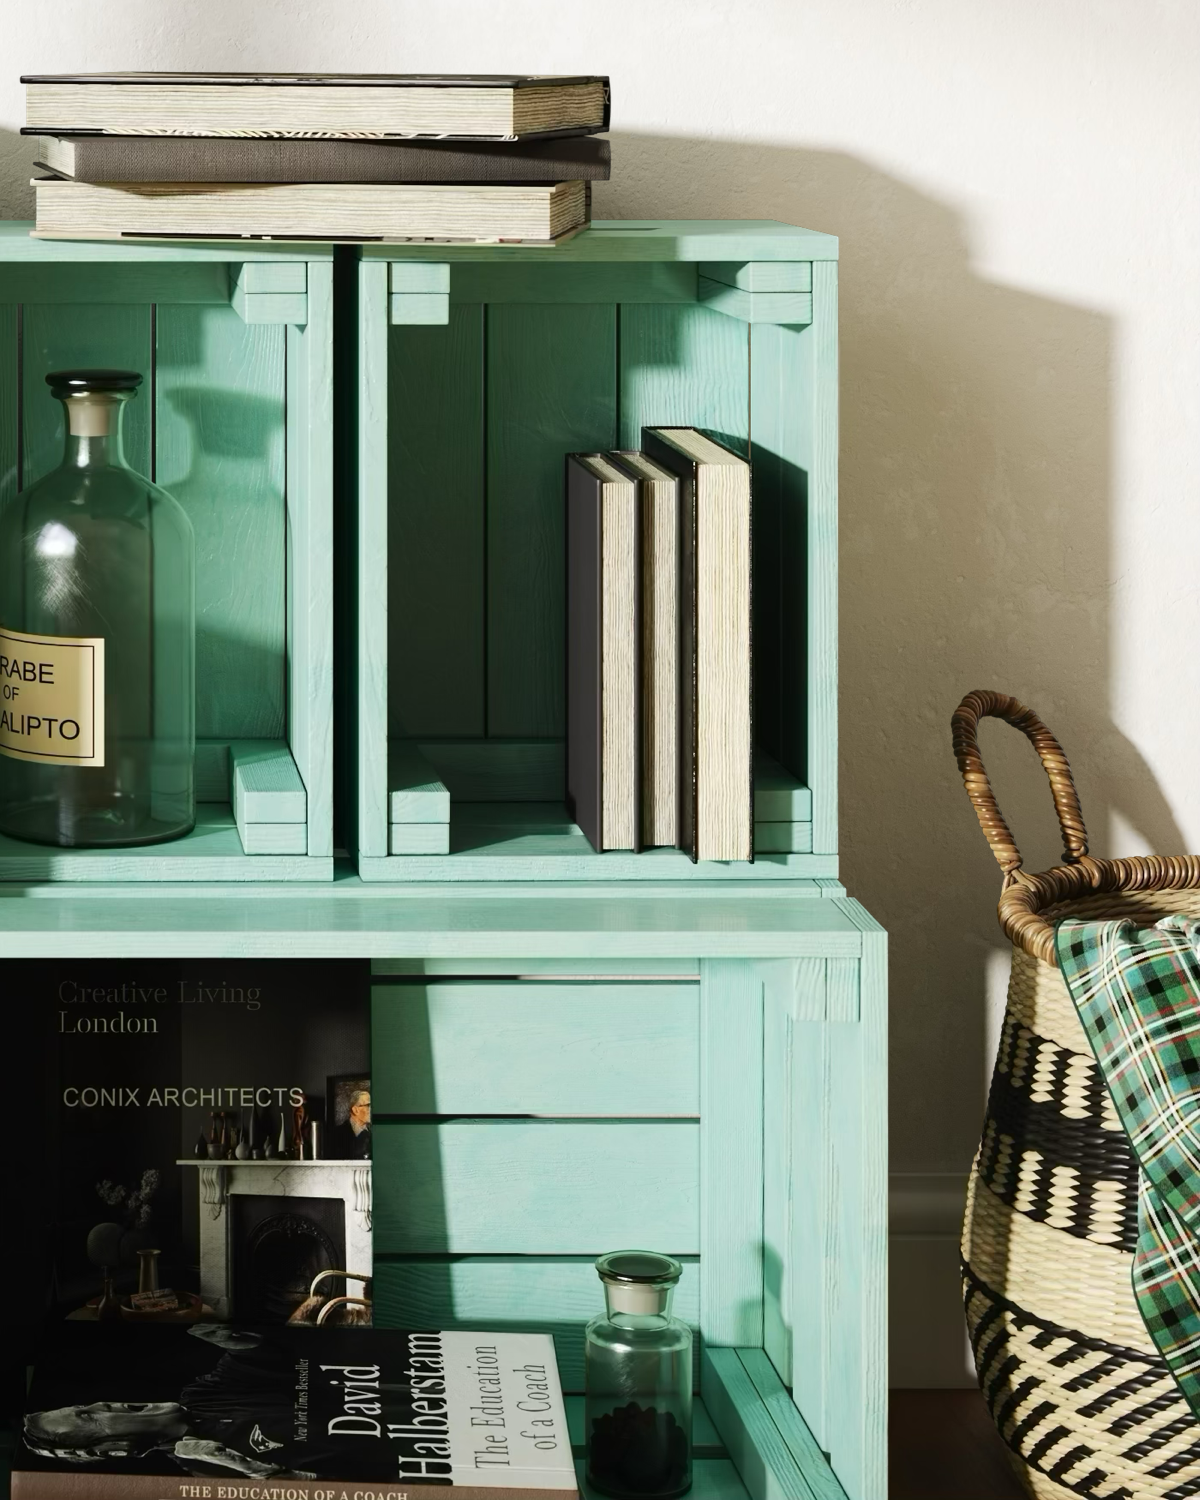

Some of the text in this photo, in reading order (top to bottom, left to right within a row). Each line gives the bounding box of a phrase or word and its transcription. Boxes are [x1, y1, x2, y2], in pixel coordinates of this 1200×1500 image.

[3, 684, 20, 701] OF
[58, 980, 262, 1010] Creative Living
[58, 1010, 159, 1034] London
[63, 1087, 305, 1107] CONIX ARCHITECTS
[293, 1358, 309, 1442] New York Times Bestseller
[319, 1364, 382, 1438] David
[386, 1332, 453, 1479] Halberstam
[467, 1346, 511, 1469] The Education
[513, 1364, 558, 1450] of a Coach
[179, 1485, 212, 1498] THE
[217, 1486, 310, 1500] EDUCATION
[314, 1490, 336, 1500] OF
[340, 1491, 350, 1500] A
